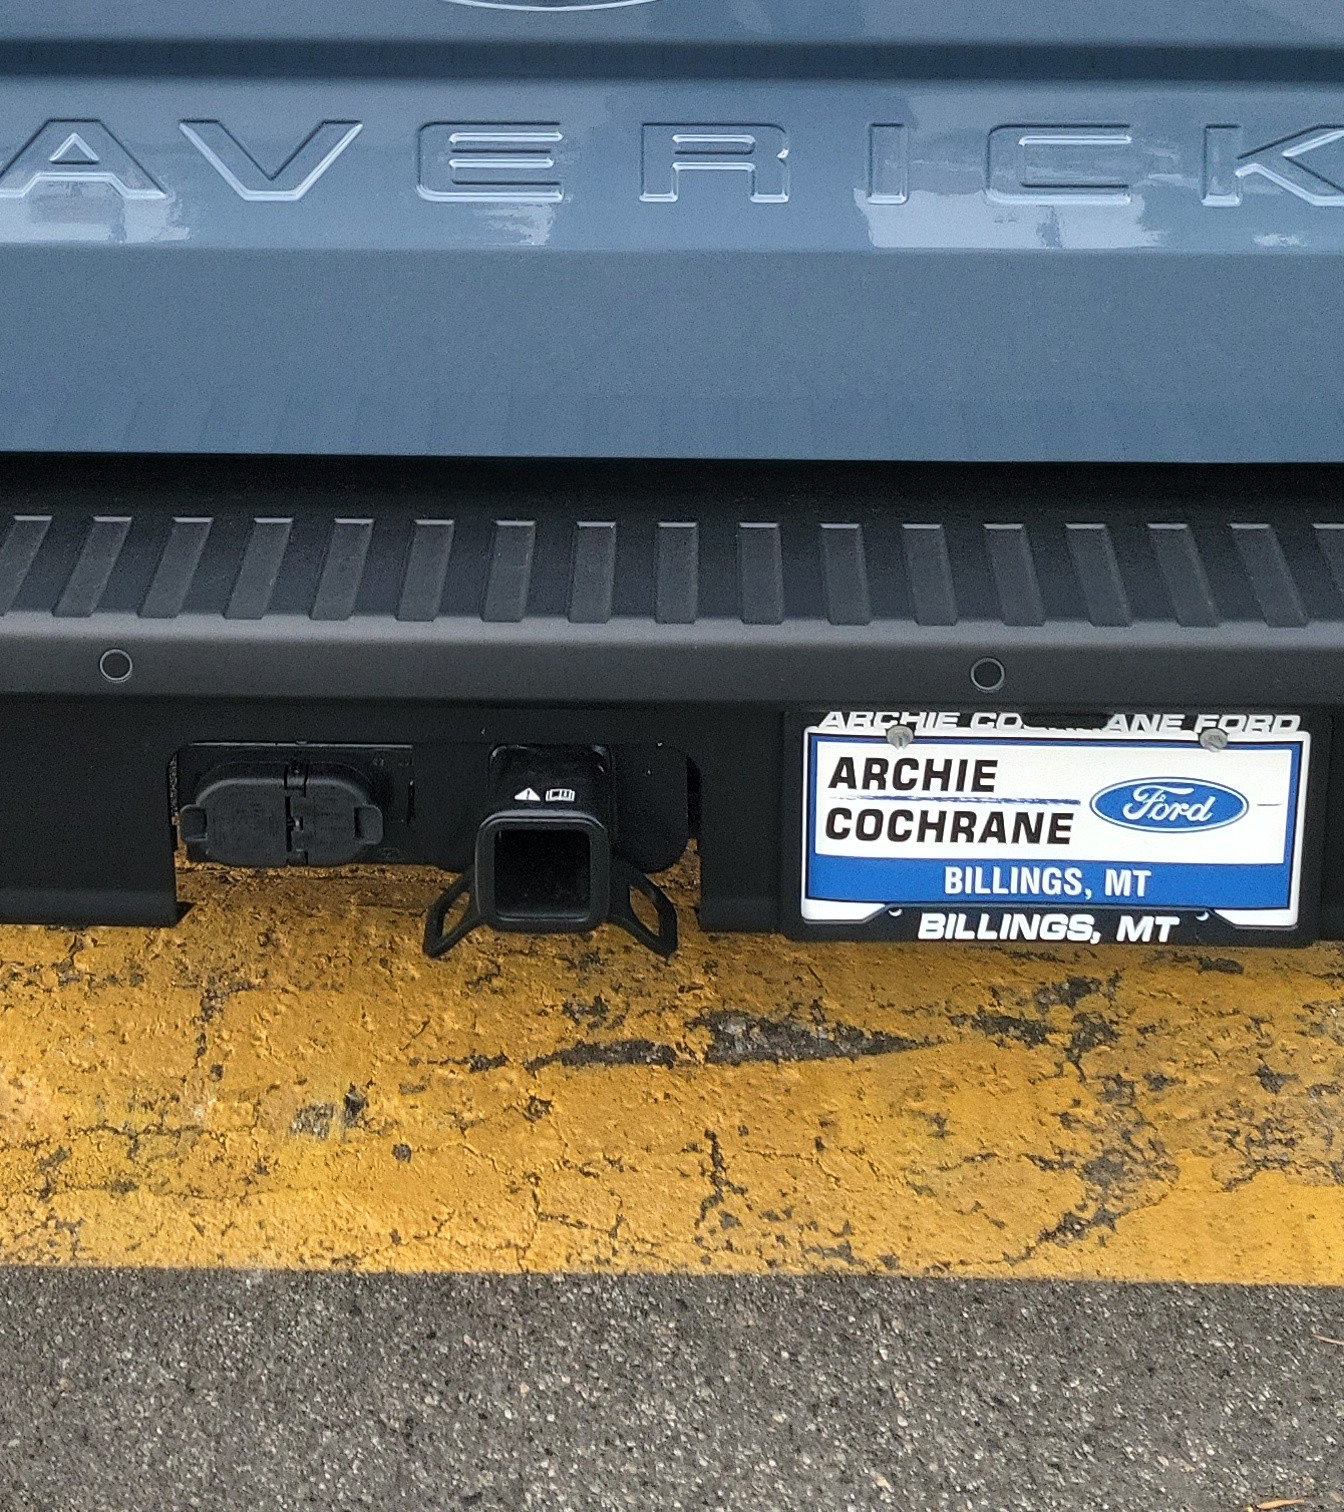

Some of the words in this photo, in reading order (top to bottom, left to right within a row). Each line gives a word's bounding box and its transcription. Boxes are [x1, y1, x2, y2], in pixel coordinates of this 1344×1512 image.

[817, 711, 960, 730] ARCHIE
[970, 712, 1186, 733] COANE
[1192, 714, 1302, 733] FORD
[828, 756, 999, 793] ARCHIE
[1122, 785, 1215, 824] Ford
[825, 806, 1074, 845] COCHRANE
[944, 865, 1094, 901] BILLINGS,
[1105, 869, 1152, 898] MT
[917, 912, 1103, 945] BILLINGS,
[1115, 914, 1180, 943] MT
